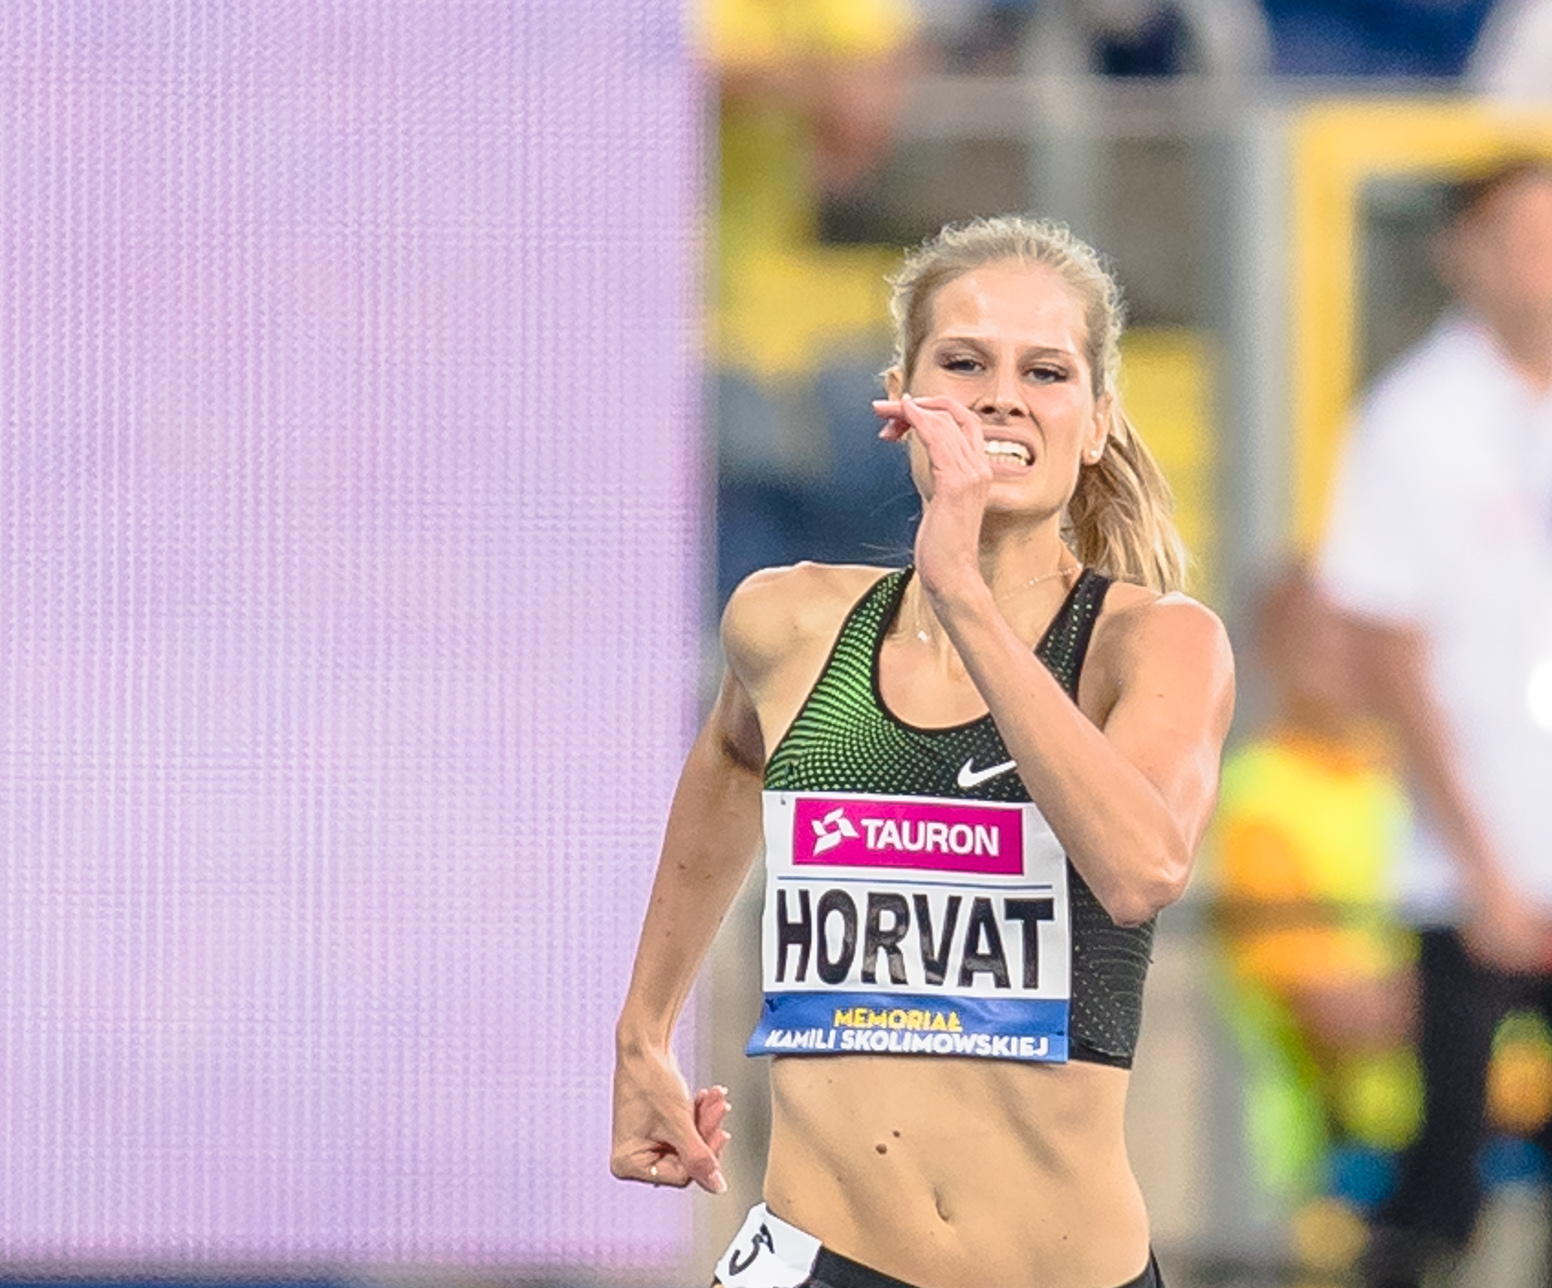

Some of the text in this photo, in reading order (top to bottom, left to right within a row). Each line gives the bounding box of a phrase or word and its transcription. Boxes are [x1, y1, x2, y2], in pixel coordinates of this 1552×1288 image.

[861, 818, 999, 857] TAURON
[775, 888, 1055, 990] HORVAT
[833, 1007, 963, 1032] MEMORIAŁ
[764, 1029, 1049, 1057] KAMILI SKOLIMOWSKIEJ
